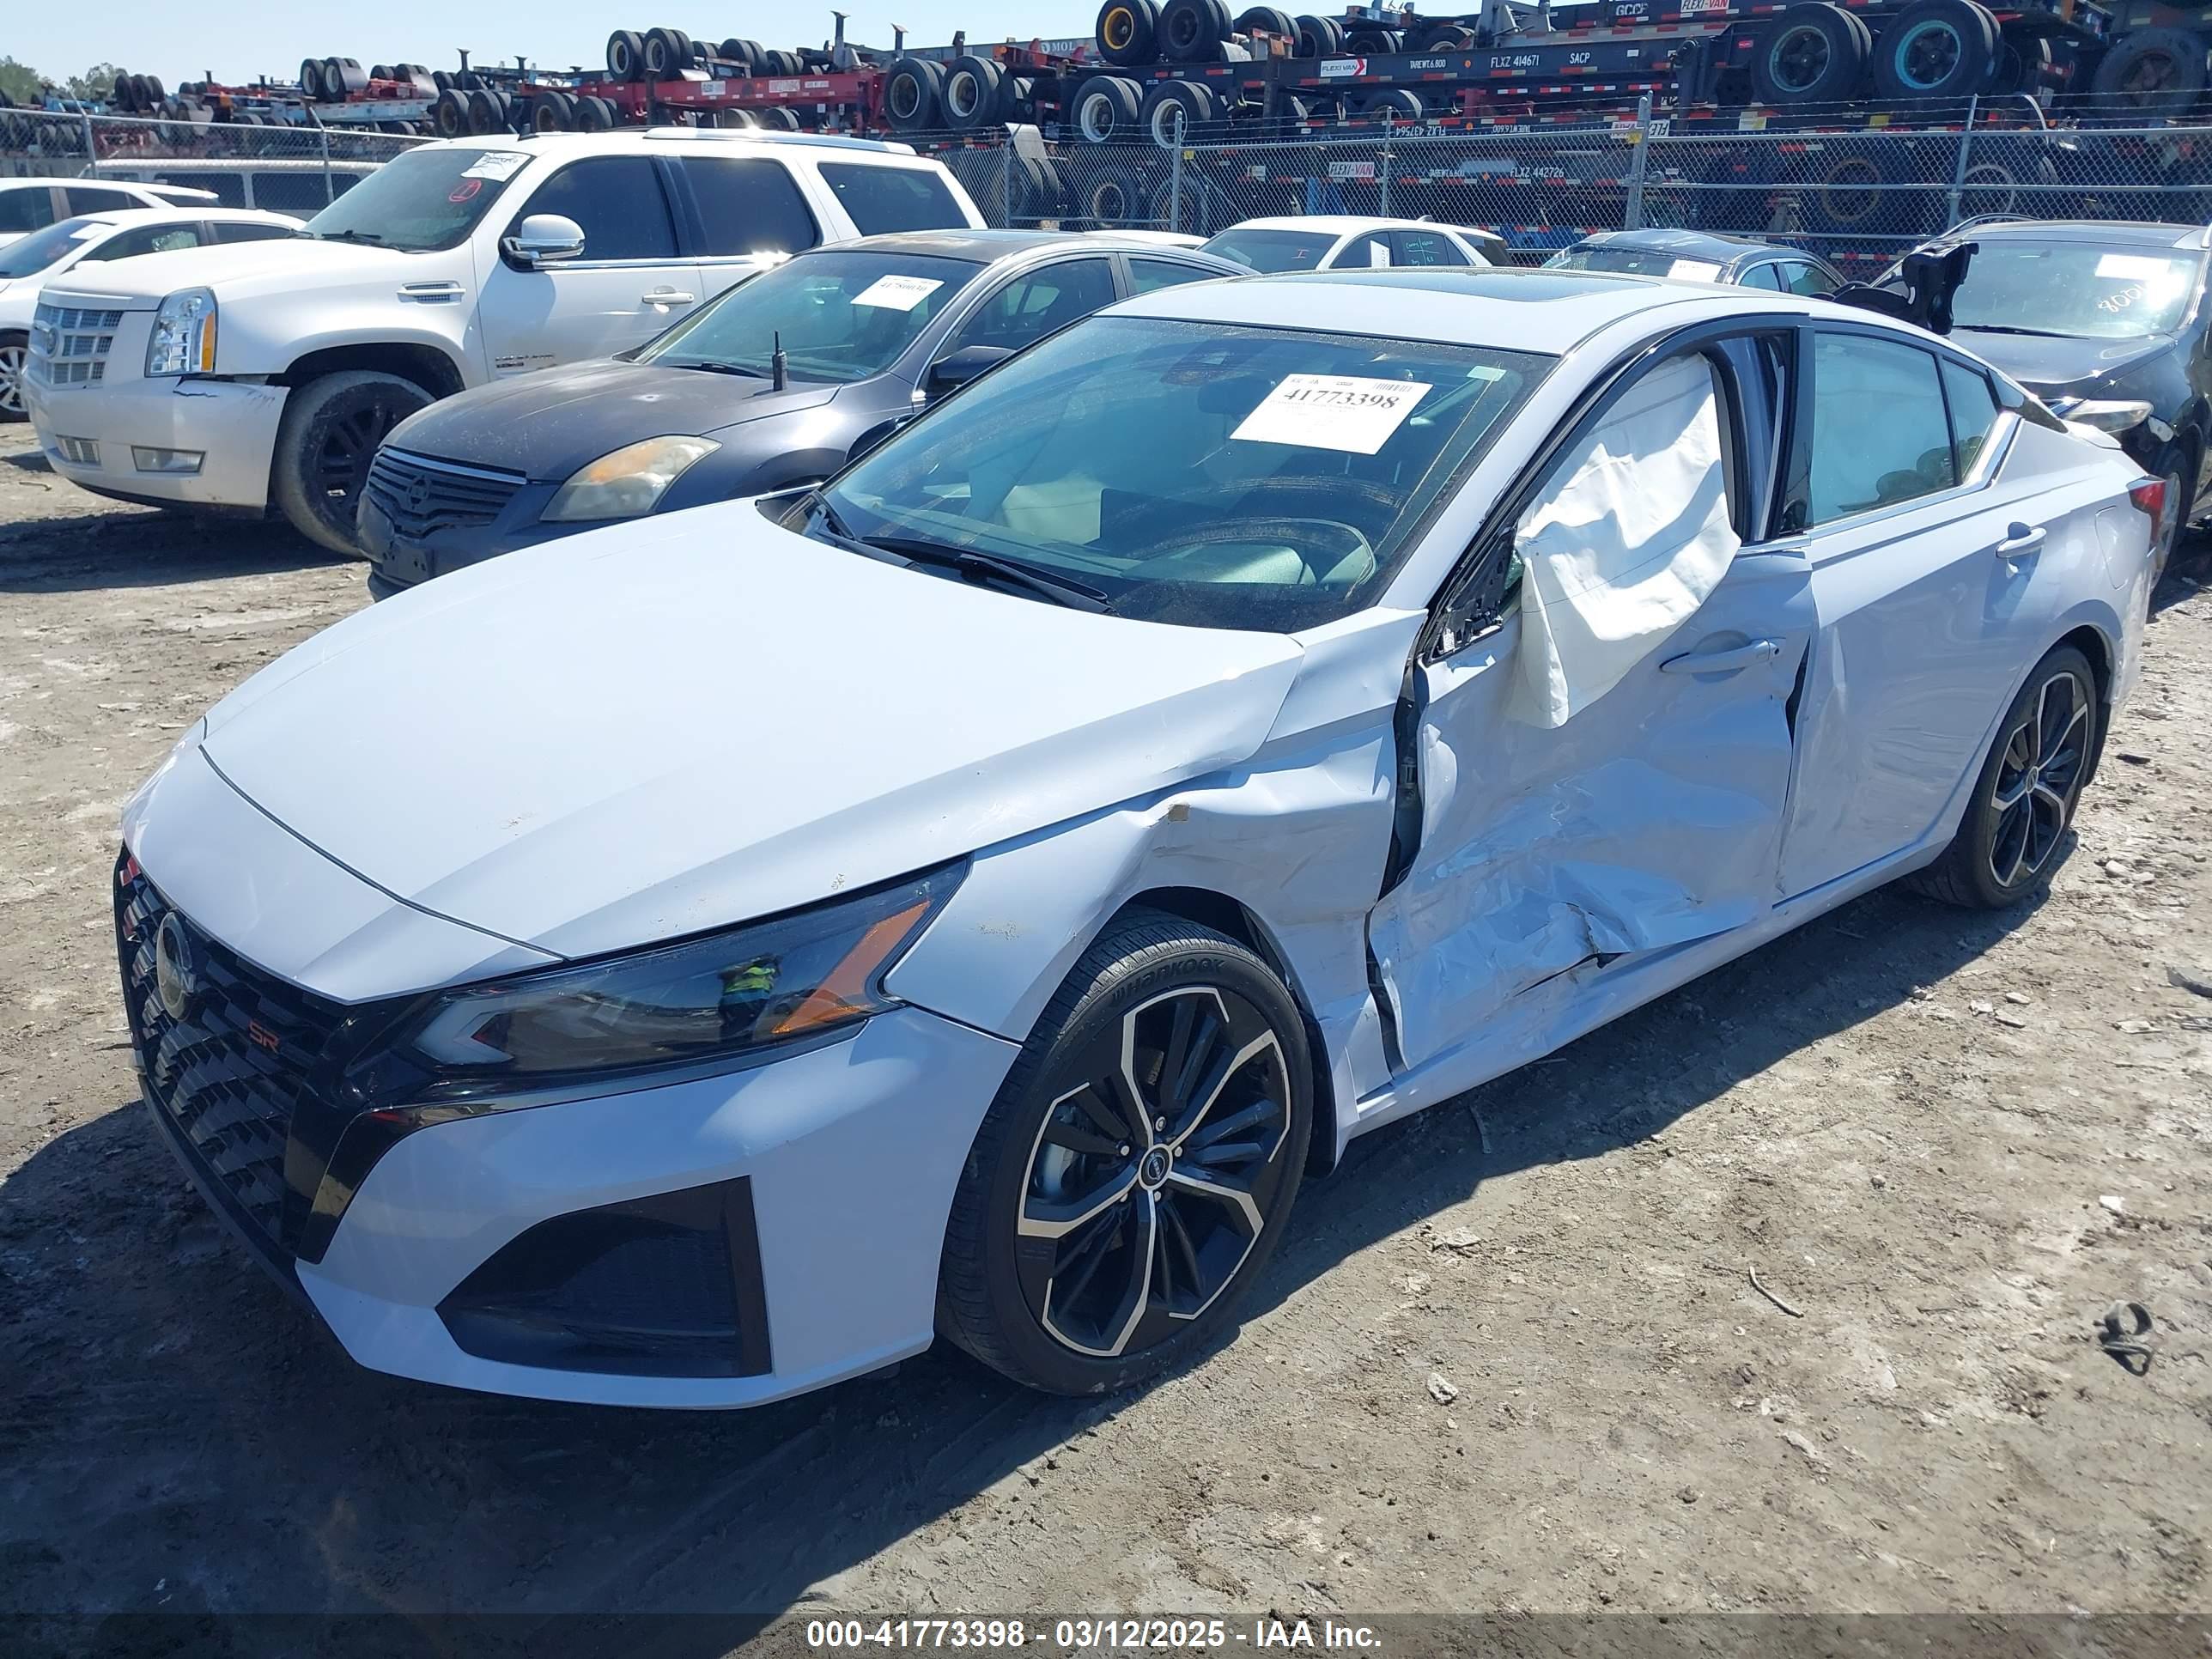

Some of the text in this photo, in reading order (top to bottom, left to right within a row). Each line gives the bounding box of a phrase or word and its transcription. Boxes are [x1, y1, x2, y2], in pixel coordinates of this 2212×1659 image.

[1491, 54, 1540, 68] FLXZ 414671
[1570, 52, 1591, 64] SACP
[1510, 167, 1565, 178] FLXZ 442726
[1284, 388, 1401, 410] 41773398
[247, 1019, 281, 1050] SR
